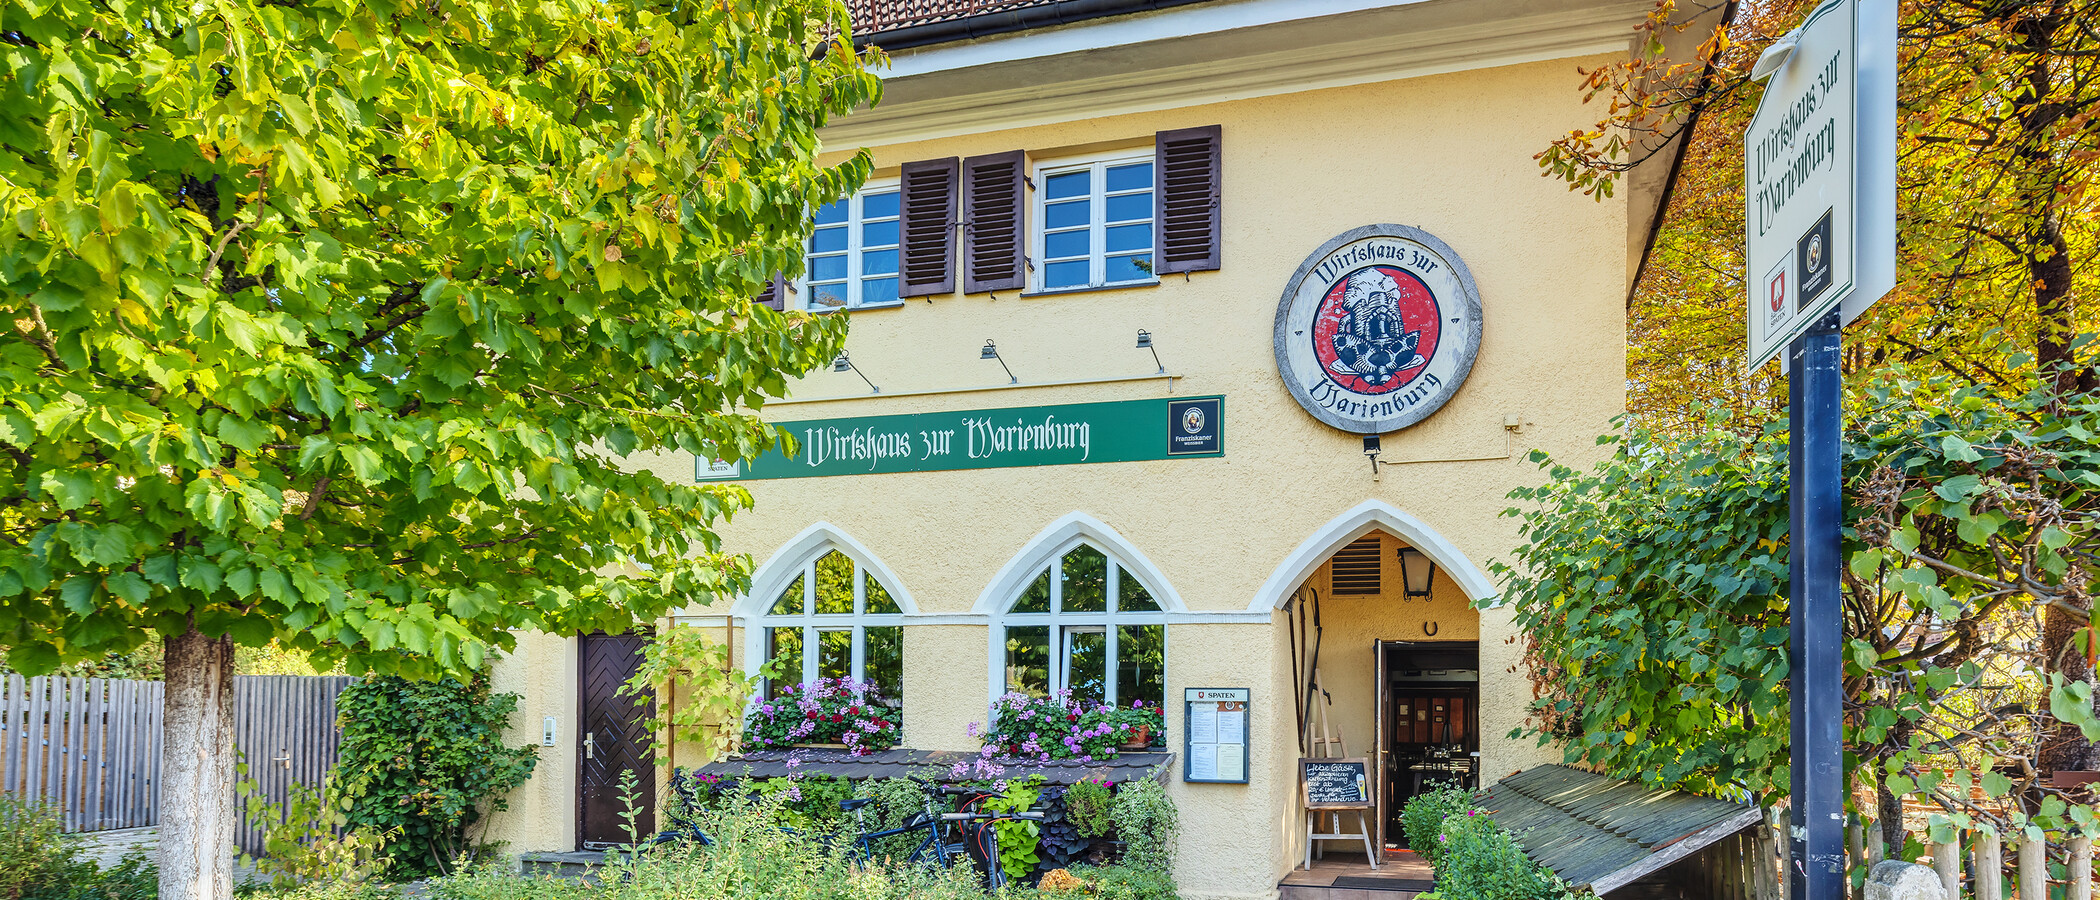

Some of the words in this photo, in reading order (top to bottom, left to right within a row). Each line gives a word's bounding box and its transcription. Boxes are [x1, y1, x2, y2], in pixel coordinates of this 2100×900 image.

[1756, 83, 1816, 186] Wirtshaus
[1817, 49, 1841, 110] zur
[1756, 117, 1835, 237] Marienburg
[1313, 241, 1406, 285] Wirtshaus
[1407, 250, 1439, 274] zur
[1309, 371, 1443, 418] Marienburg
[805, 426, 911, 471] Wirtshaus
[919, 429, 955, 460] zur
[962, 415, 1090, 461] Marienburg
[1307, 763, 1330, 772] Liebe
